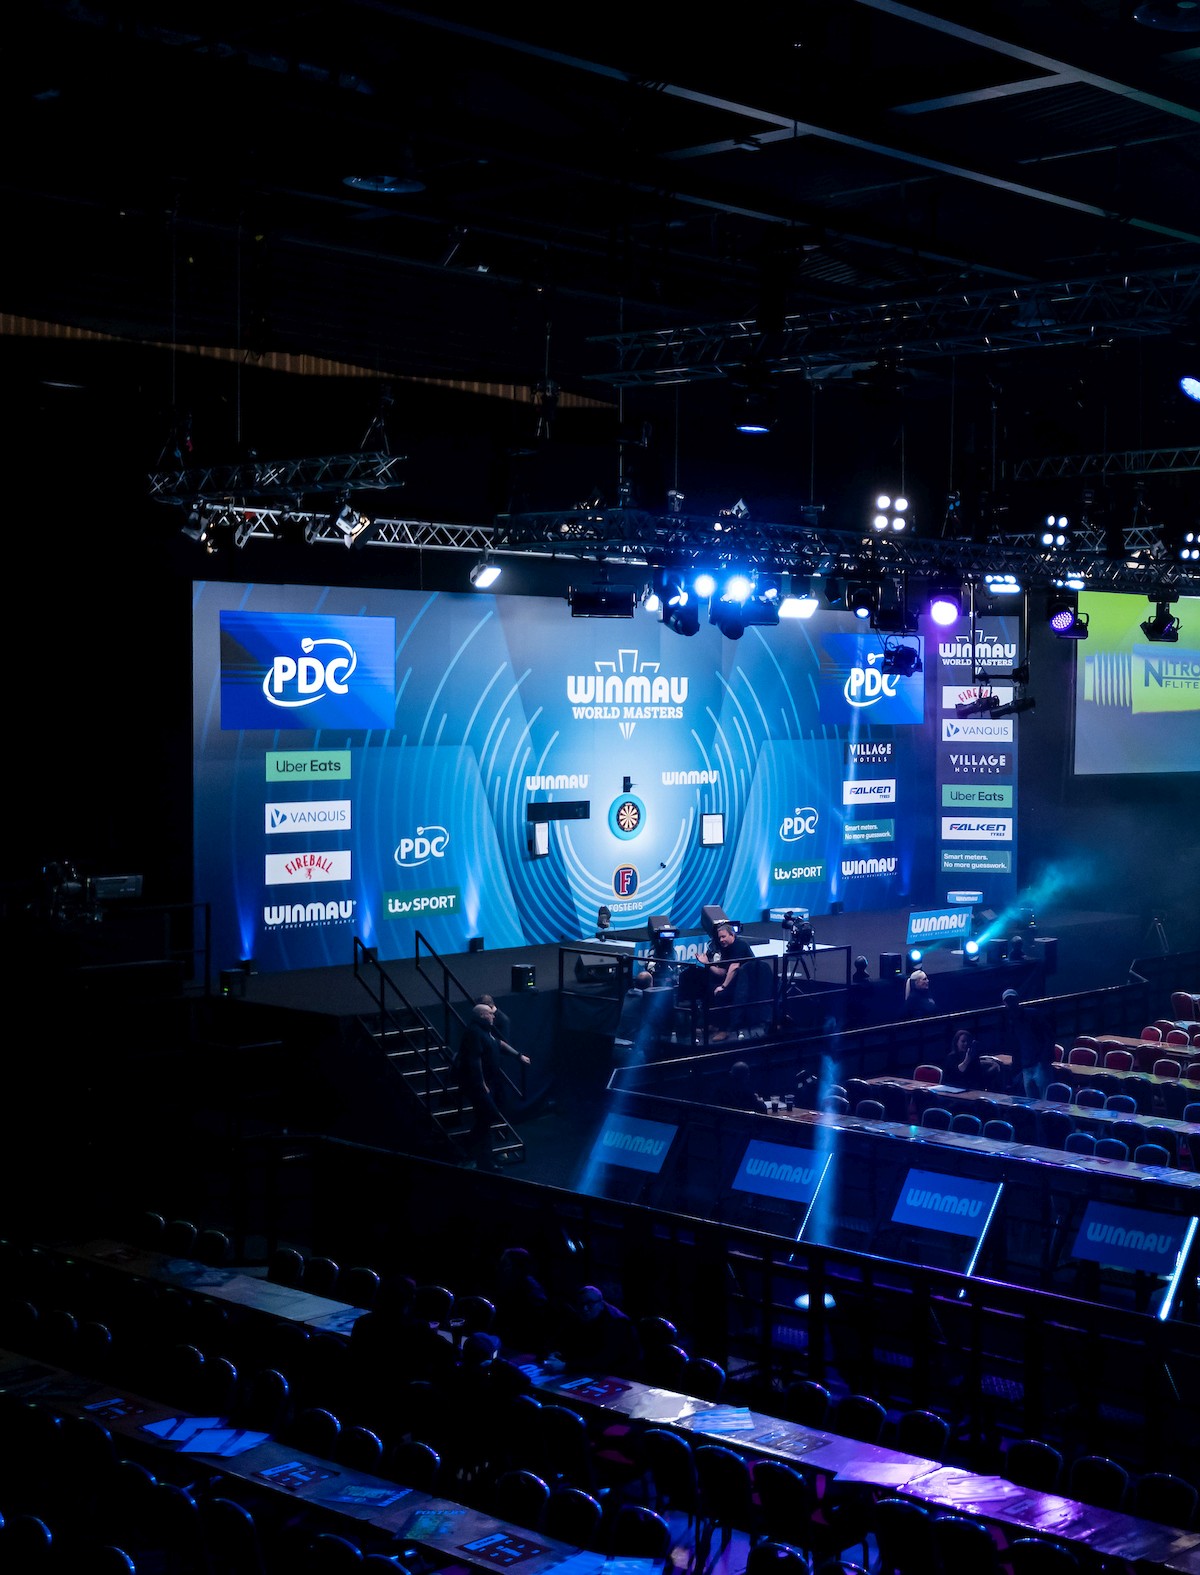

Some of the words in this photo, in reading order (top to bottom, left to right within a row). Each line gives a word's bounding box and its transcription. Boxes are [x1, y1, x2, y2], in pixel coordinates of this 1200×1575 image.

[939, 643, 1016, 658] WINMAU
[942, 658, 972, 666] WORLD
[274, 656, 349, 695] PDC
[567, 675, 689, 704] WINMAU
[1165, 681, 1200, 689] FLITE
[572, 706, 620, 719] WORLD
[623, 706, 683, 719] MASTERS
[962, 726, 1009, 736] VANQUIS
[849, 743, 892, 755] VILLAGE
[276, 760, 306, 773] Uber
[310, 759, 341, 772] Eats
[949, 754, 1006, 766] VILLAGE
[526, 774, 588, 791] WINMAU
[662, 770, 718, 786] WINMAU
[850, 786, 891, 795] FALKEN
[950, 791, 976, 800] Uber
[978, 791, 1004, 801] Eats
[290, 810, 346, 824] VANQUIS
[783, 815, 816, 835] PDC
[949, 823, 1006, 832] FALKEN
[400, 836, 445, 860] PDC
[285, 854, 334, 874] FIREBALL
[842, 857, 897, 876] WINMAU
[971, 862, 1007, 870] guesswork.
[619, 868, 634, 895] F
[264, 899, 353, 925] WINMAU
[911, 913, 967, 934] WINMAU
[603, 1129, 665, 1156] WINMAU
[746, 1158, 815, 1185] WINMAU
[906, 1188, 983, 1218] WINMAU
[1086, 1221, 1173, 1254] WINMAU
